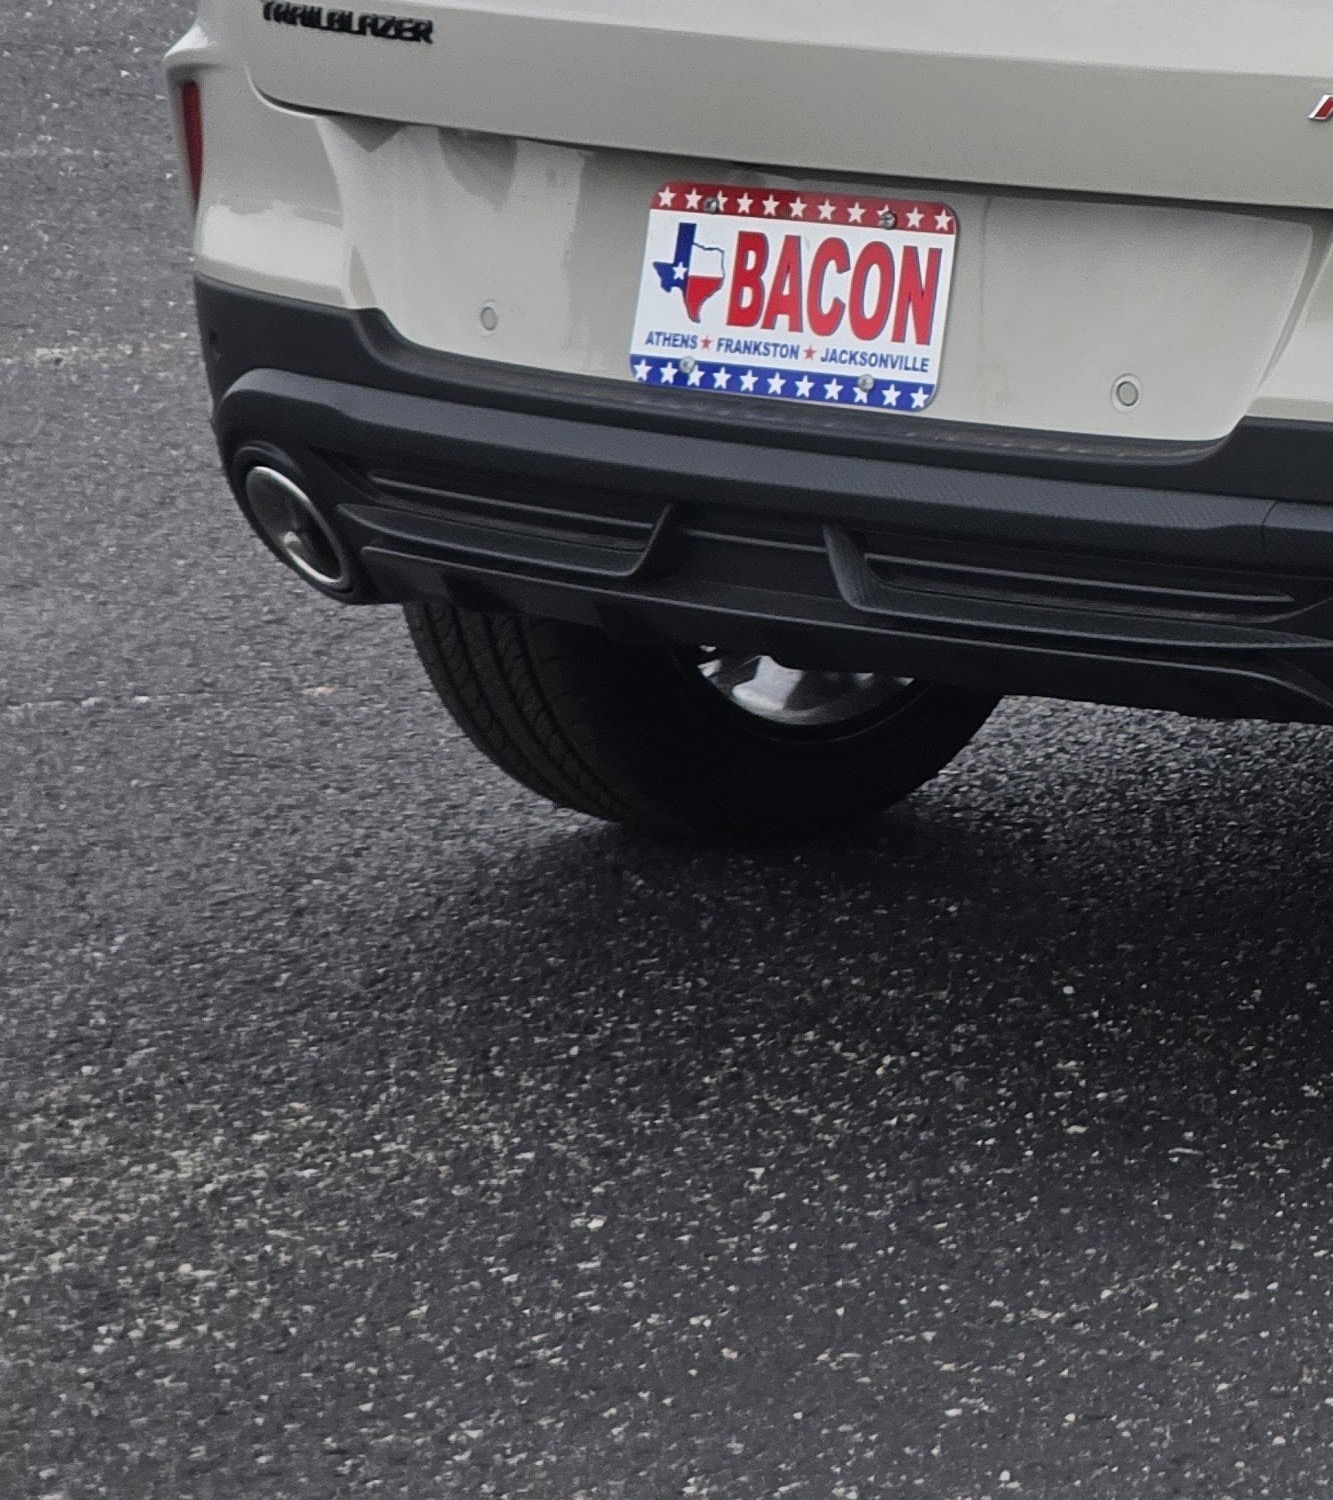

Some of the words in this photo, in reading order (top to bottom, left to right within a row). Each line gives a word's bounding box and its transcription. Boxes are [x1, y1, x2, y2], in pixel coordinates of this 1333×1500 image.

[726, 230, 943, 346] BACON
[645, 330, 699, 351] ATHENS
[716, 337, 800, 361] FRANKSTON
[820, 347, 931, 374] JACKSONVILLE
